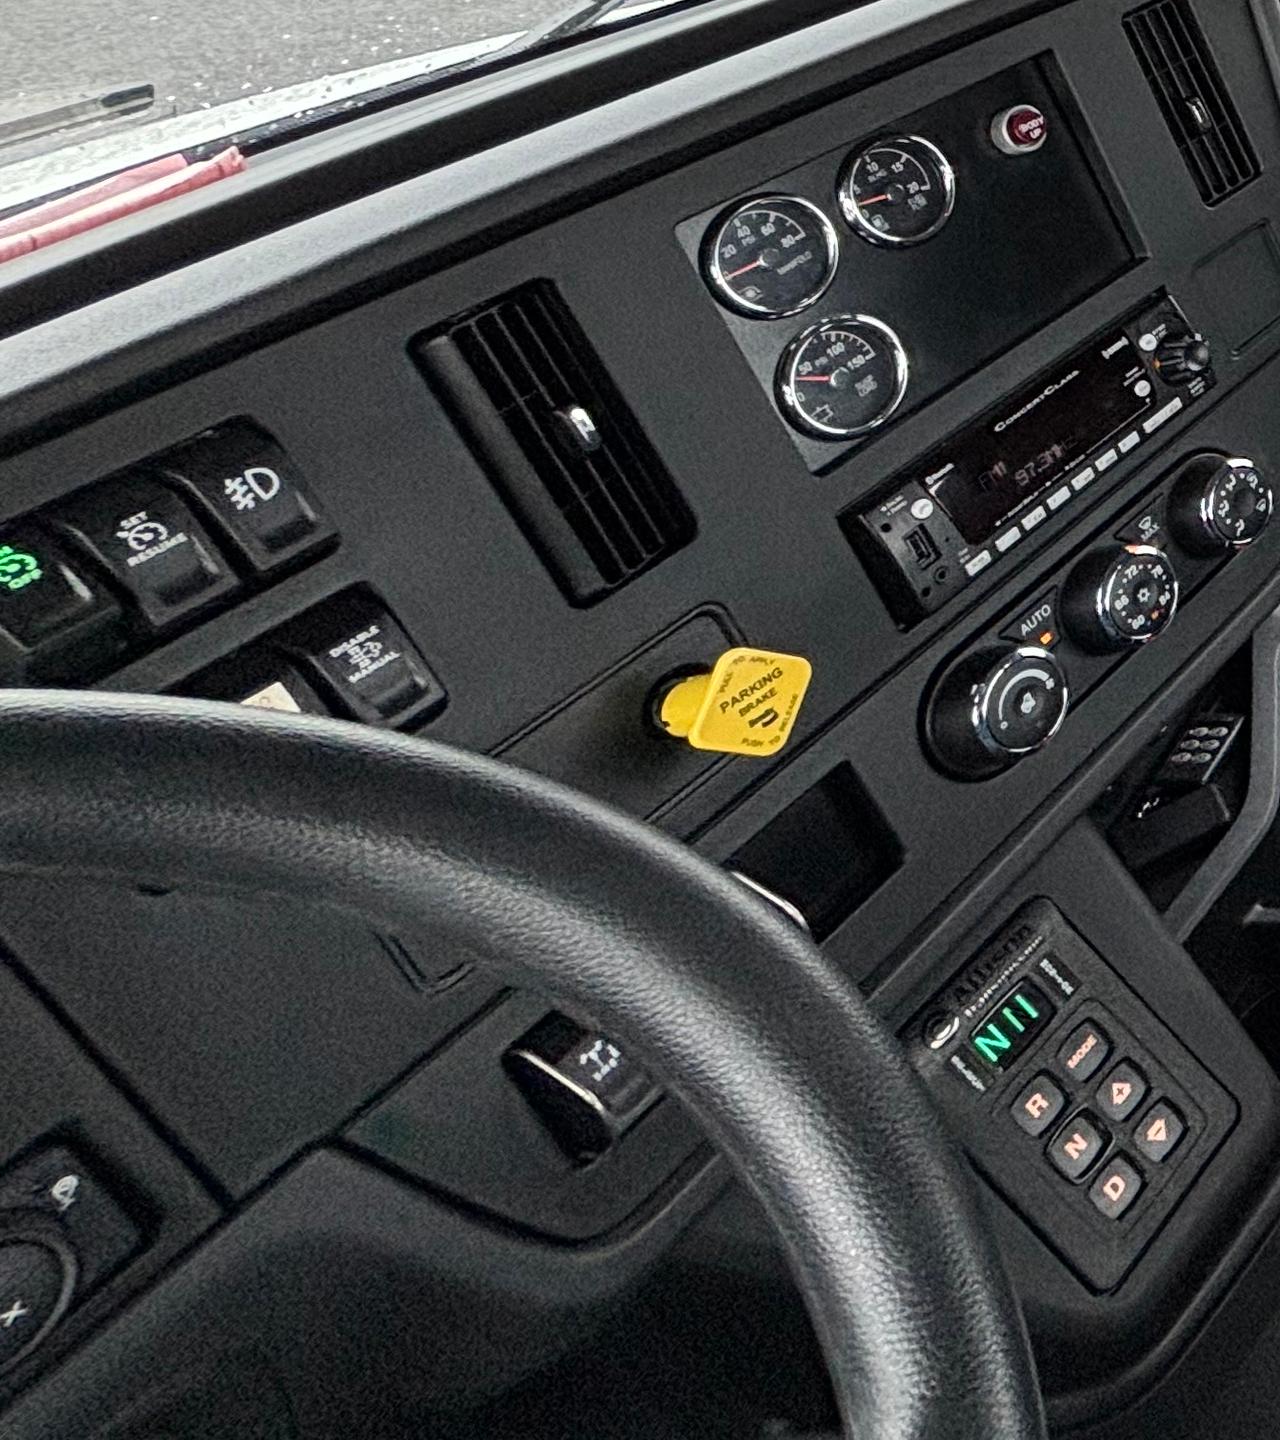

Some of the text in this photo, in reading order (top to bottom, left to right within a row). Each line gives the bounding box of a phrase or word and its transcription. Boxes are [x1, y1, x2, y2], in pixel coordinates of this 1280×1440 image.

[1018, 116, 1044, 134] BODY
[1028, 127, 1043, 140] UP
[866, 162, 880, 173] 10
[891, 162, 905, 174] 15
[906, 180, 921, 194] 20
[737, 224, 751, 239] 40
[760, 222, 776, 236] 60
[780, 234, 797, 249] 80
[720, 243, 737, 259] 20
[826, 341, 846, 359] 100
[798, 361, 813, 376] 50
[847, 353, 866, 371] 150
[120, 510, 148, 530] SET
[126, 531, 188, 568] RESUME
[1124, 564, 1139, 580] 72
[1020, 603, 1052, 637] AUTO
[1131, 614, 1146, 630] 60
[328, 625, 380, 658] DISABLE
[348, 650, 401, 684] MANUAL
[718, 671, 734, 694] PULL
[748, 656, 776, 666] APPLY
[719, 666, 784, 715] PARKING
[738, 686, 778, 718] BRAKE
[740, 693, 799, 748] PUSH TO RELEASE
[1066, 1033, 1098, 1069] MODE
[1024, 1092, 1049, 1119] R
[1064, 1132, 1088, 1160] N
[1102, 1175, 1126, 1202] D
